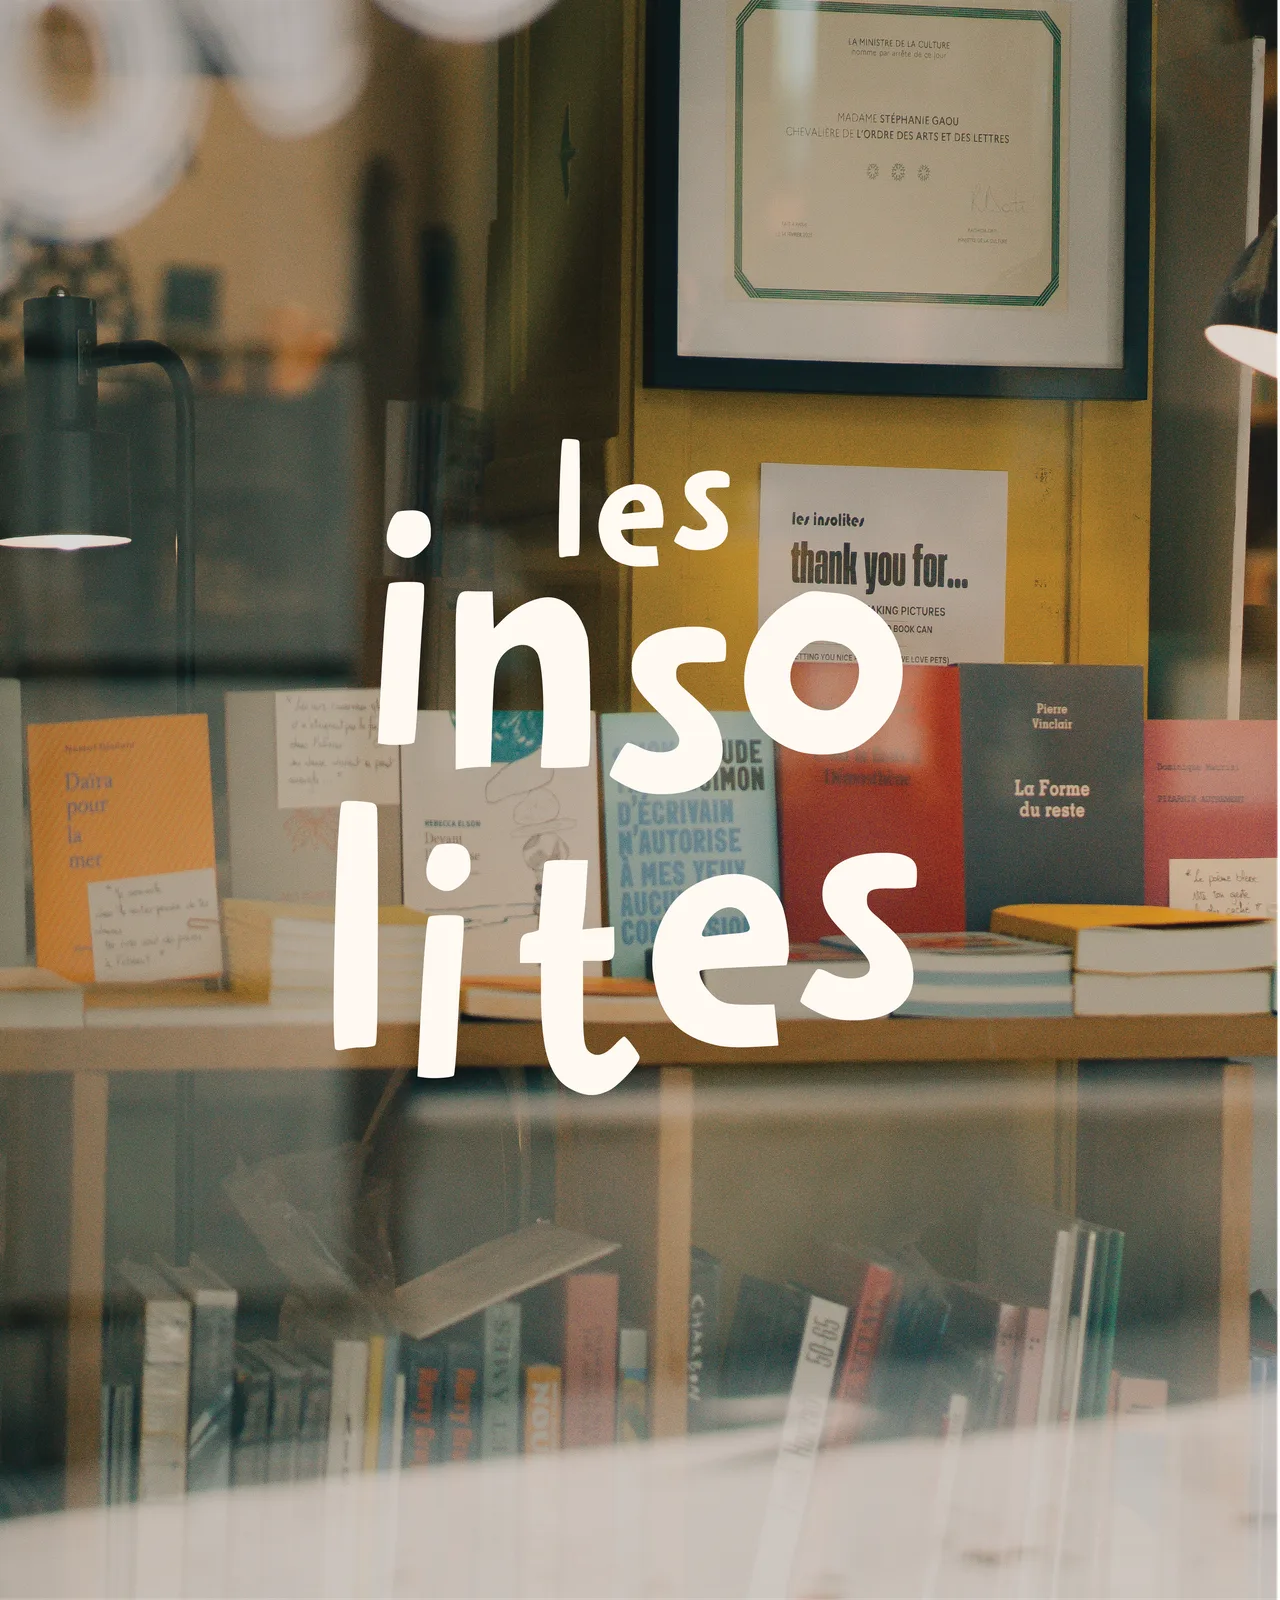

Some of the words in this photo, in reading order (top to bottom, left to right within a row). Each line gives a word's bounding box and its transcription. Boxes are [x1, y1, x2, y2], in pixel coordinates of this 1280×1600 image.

[848, 38, 857, 46] LA
[860, 38, 893, 47] MINISTRE
[895, 40, 905, 48] DE
[907, 40, 916, 48] LA
[918, 40, 950, 49] CULTURE
[914, 50, 922, 58] de
[934, 51, 947, 60] jour
[838, 113, 877, 124] MADAME
[880, 112, 930, 125] STÉPHANIE
[932, 116, 959, 126] GAOU
[843, 129, 854, 138] DE
[857, 129, 894, 140] L'ORDRE
[897, 131, 914, 140] DES
[916, 132, 939, 141] ARTS
[941, 133, 952, 142] ET
[955, 133, 972, 142] DES
[974, 134, 1010, 144] LETTRES
[792, 511, 810, 526] les
[813, 512, 865, 527] insolites
[791, 540, 858, 585] thank
[864, 551, 906, 595] you
[912, 543, 969, 589] for...
[868, 605, 898, 615] AKING
[901, 606, 946, 617] PICTURES
[893, 625, 915, 633] BOOK
[916, 626, 933, 634] CAN
[795, 653, 819, 661] ETTING
[820, 653, 836, 661] YOU
[837, 654, 854, 662] NICE
[930, 656, 951, 665] PETS)
[1036, 702, 1068, 714] Pierre
[1032, 718, 1073, 729] Vinclair
[1014, 779, 1035, 797] La
[1039, 779, 1091, 797] Forme
[66, 799, 108, 821] pour
[618, 793, 735, 826] D'ÉCRIVAIN
[1020, 800, 1041, 818] du
[1045, 803, 1086, 818] reste
[424, 819, 456, 828] REBECCA
[458, 819, 481, 828] ELSON
[67, 825, 82, 844] la
[619, 824, 742, 855] N'AUTORISE
[69, 853, 104, 869] mer
[619, 852, 634, 887] À
[641, 861, 686, 886] MES
[806, 1315, 841, 1370] 50-65
